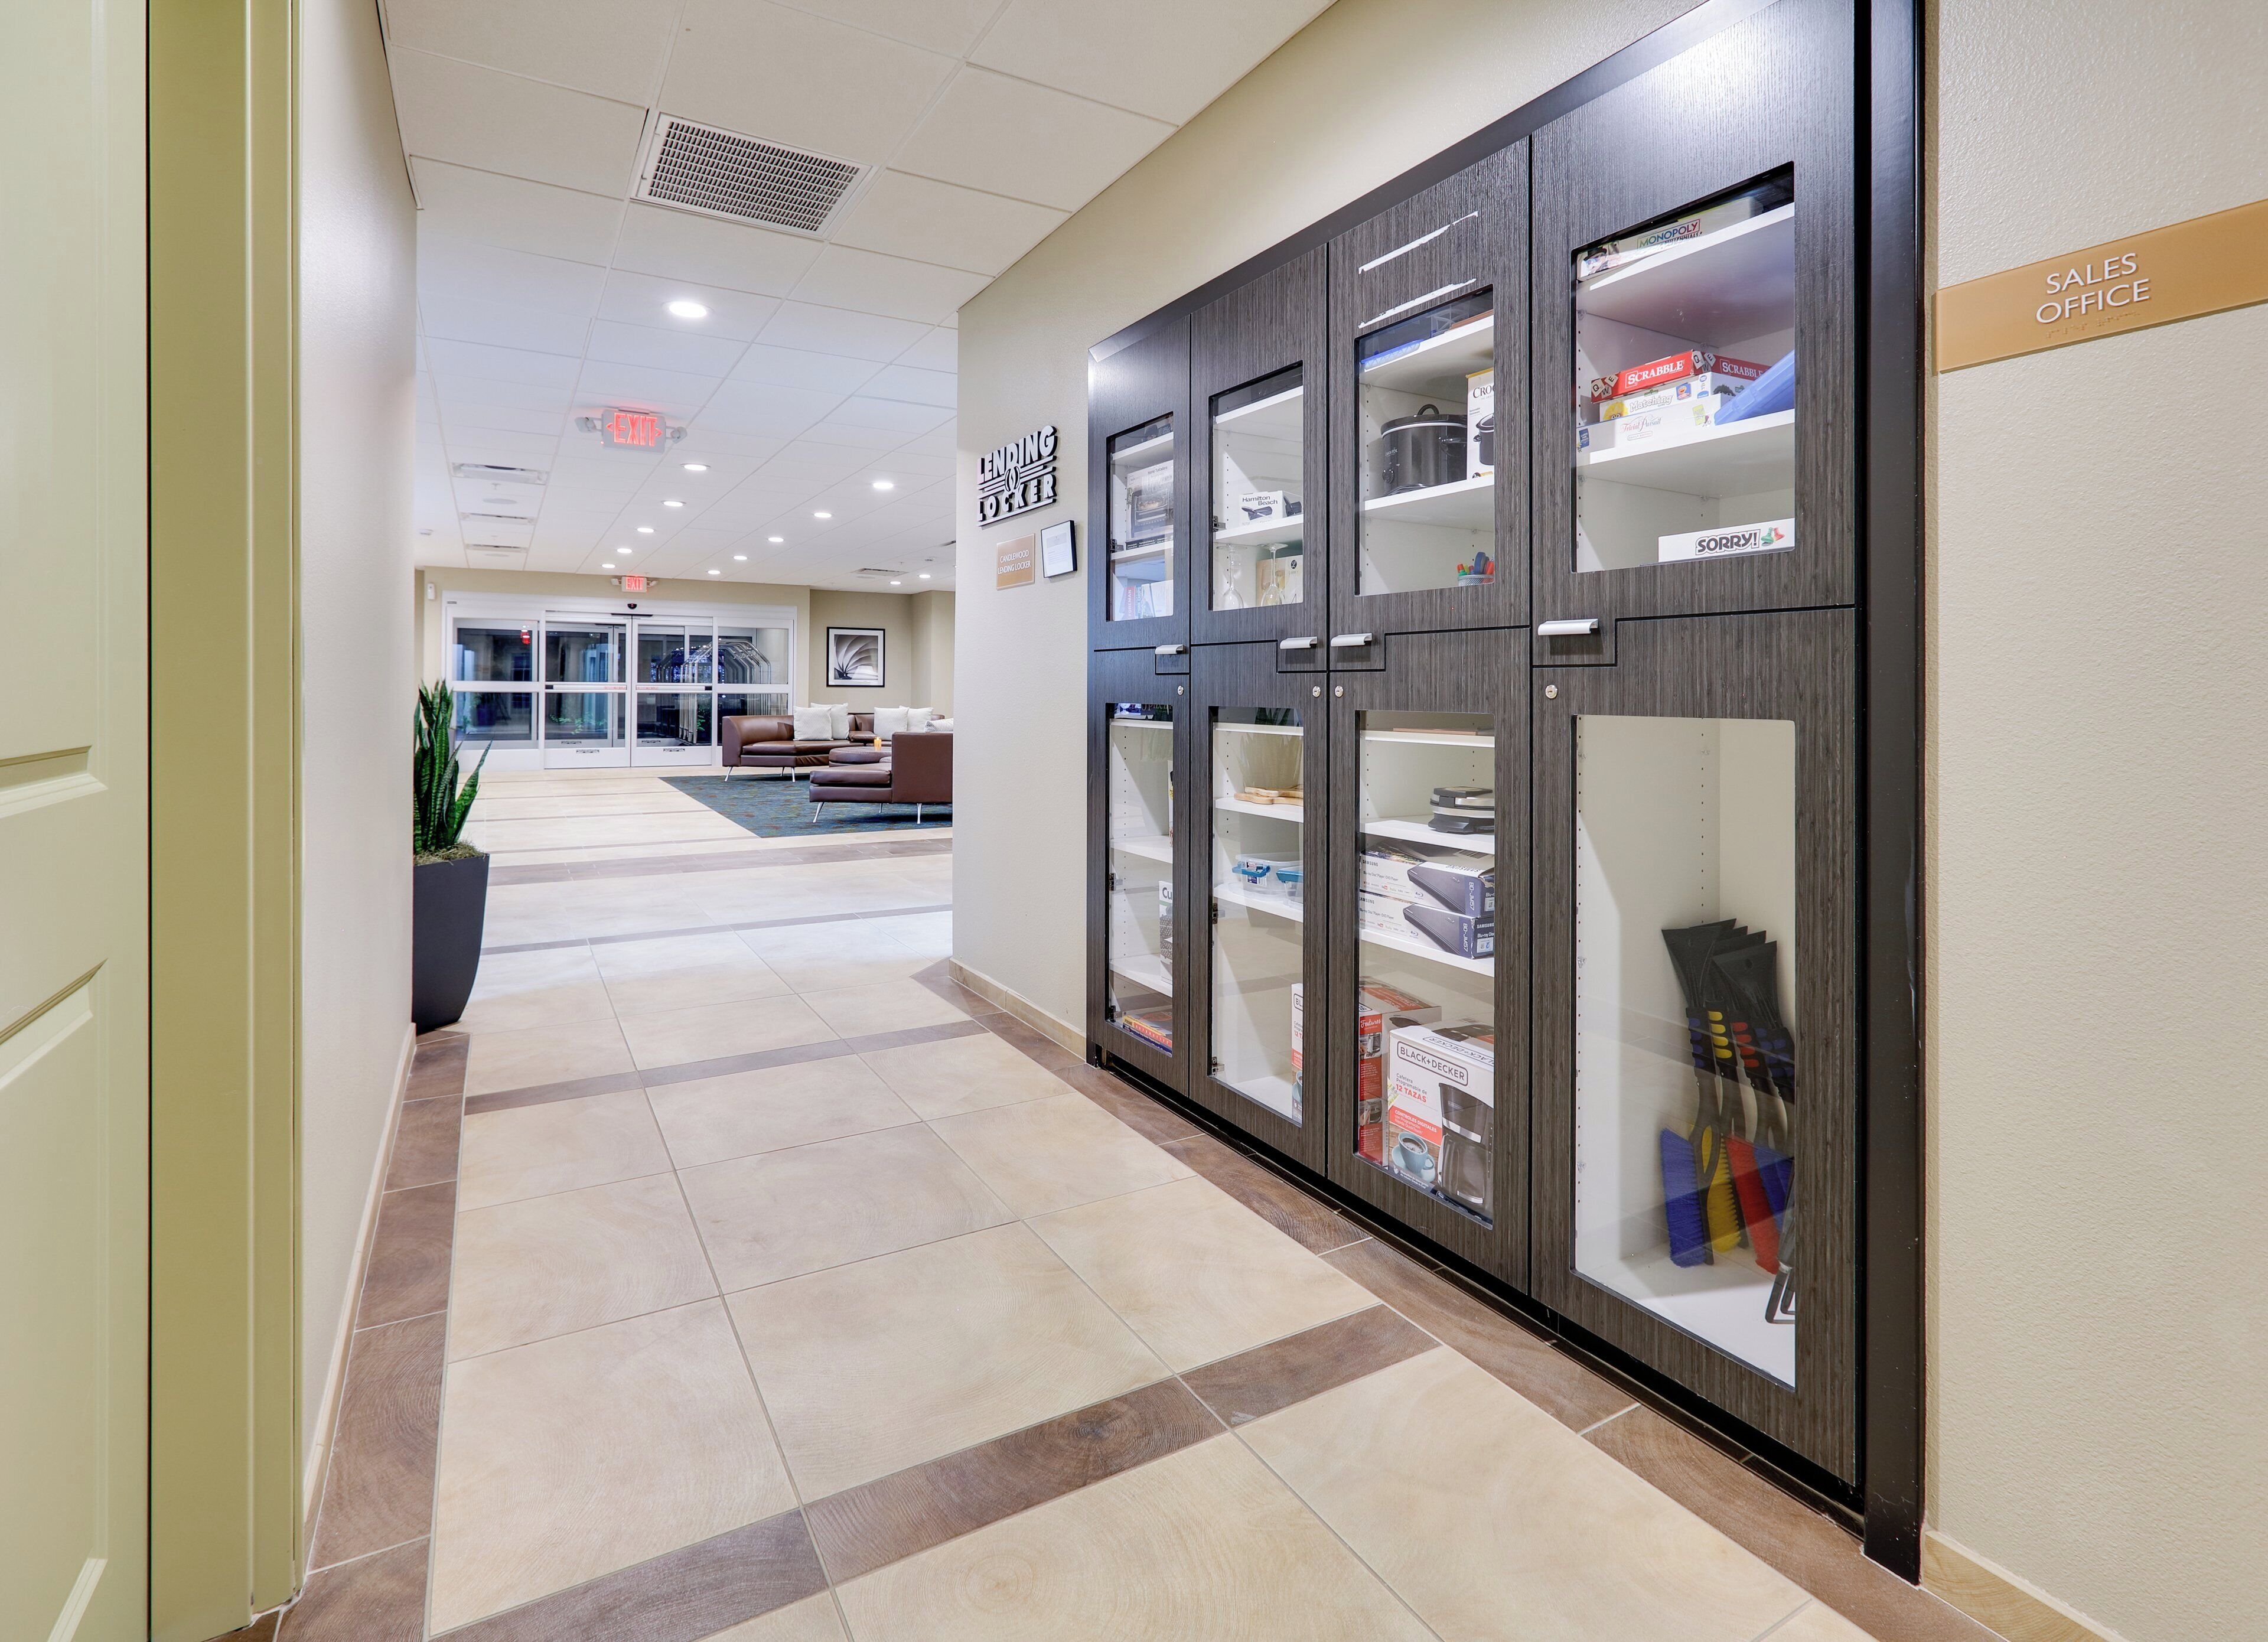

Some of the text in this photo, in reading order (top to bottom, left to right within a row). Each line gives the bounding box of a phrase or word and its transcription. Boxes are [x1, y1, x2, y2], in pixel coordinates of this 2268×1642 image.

[1640, 221, 1698, 248] MONOPOLY
[2046, 253, 2137, 295] SALES
[2035, 278, 2150, 324] OFFICE
[1627, 360, 1684, 385] SCRABBLE
[1473, 385, 1494, 399] CRO
[1592, 383, 1600, 393] Q
[1630, 395, 1673, 413] Matching
[614, 412, 657, 447] EXIT
[1622, 421, 1640, 433] Trivial
[1639, 415, 1661, 432] Pursuit
[977, 425, 1057, 485] LENDING
[976, 474, 1057, 522] LOCKER
[1697, 532, 1758, 553] SORRY!
[1000, 550, 1029, 563] CANDLEWOOD
[998, 560, 1031, 575] LENDING LOCKER
[626, 576, 644, 591] EXIT
[1360, 1018, 1381, 1028] Features
[1429, 1037, 1494, 1064] LACK+DECKER
[1400, 1047, 1465, 1081] BLACK+DECKER
[1396, 1073, 1413, 1083] Cafetera
[1396, 1078, 1421, 1092] Programable
[1396, 1084, 1403, 1092] 12
[1404, 1087, 1427, 1103] TAZAS
[1394, 1110, 1437, 1133] CONTROLES DIGITALES
